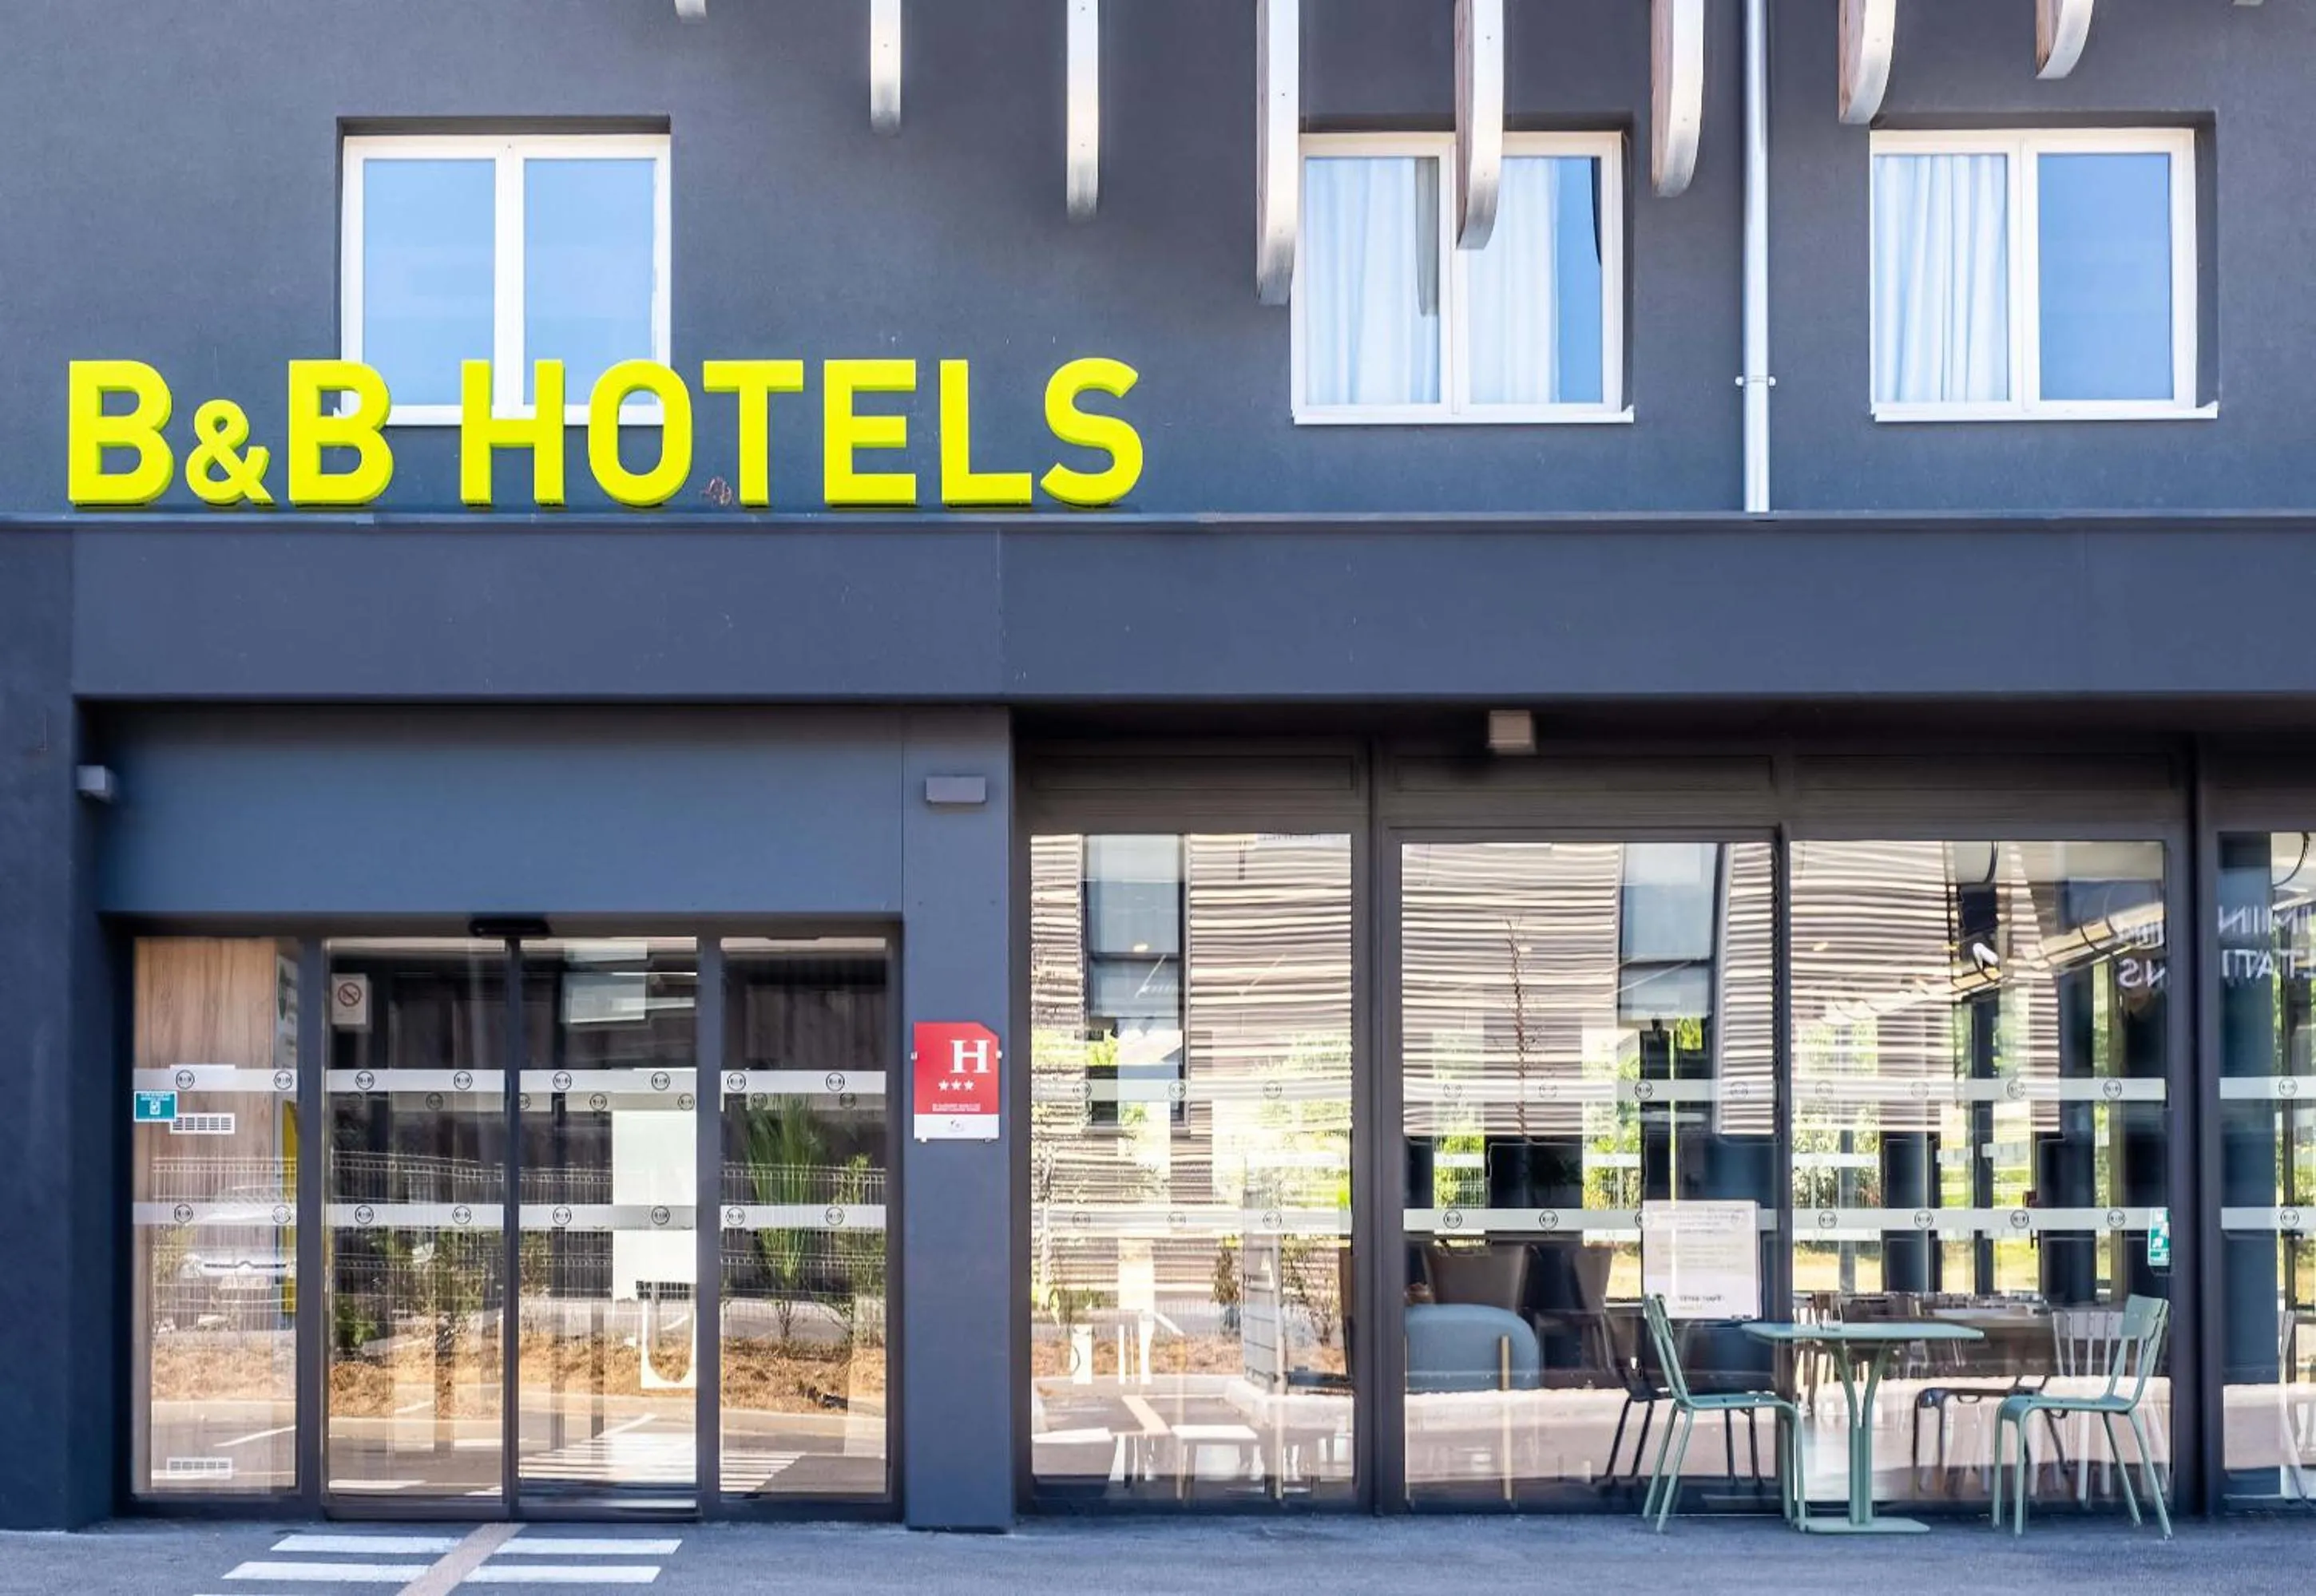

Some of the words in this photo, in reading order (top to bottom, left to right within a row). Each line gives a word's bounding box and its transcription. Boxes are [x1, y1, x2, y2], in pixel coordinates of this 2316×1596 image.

[67, 360, 393, 506] B&B
[460, 358, 1145, 507] HOTELS
[950, 1039, 992, 1073] H
